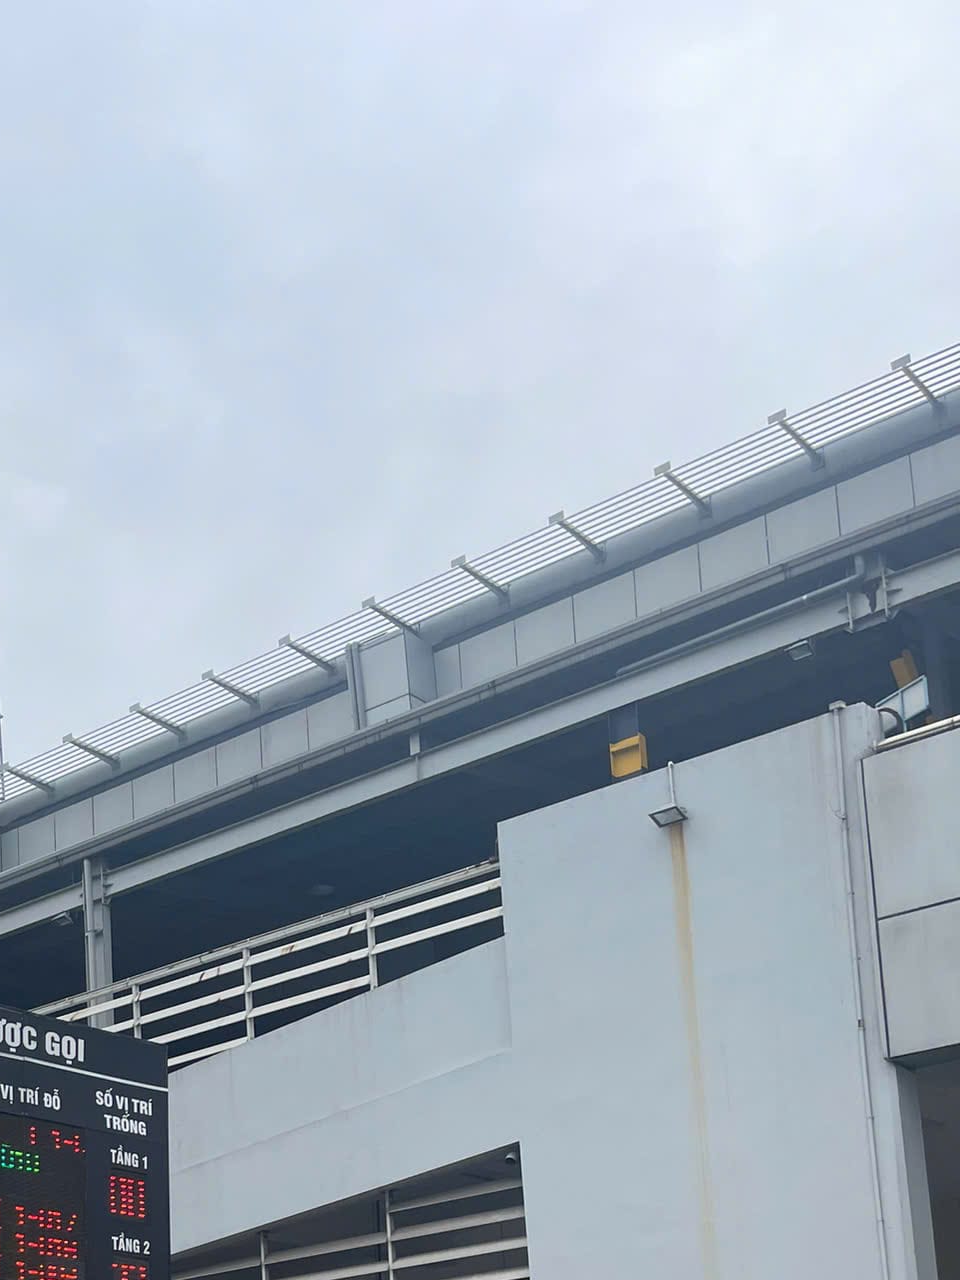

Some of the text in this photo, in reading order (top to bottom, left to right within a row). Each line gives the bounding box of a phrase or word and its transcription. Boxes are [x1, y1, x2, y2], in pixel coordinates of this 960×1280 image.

[45, 1029, 86, 1065] GỌI
[0, 1083, 61, 1111] VỊ TRÍ ĐỖ
[95, 1087, 153, 1117] SỐ VỊ TRÍ
[103, 1113, 147, 1136] TRỐNG
[109, 1144, 148, 1170] TẦNG 1
[111, 1232, 151, 1255] TẦNG 2
